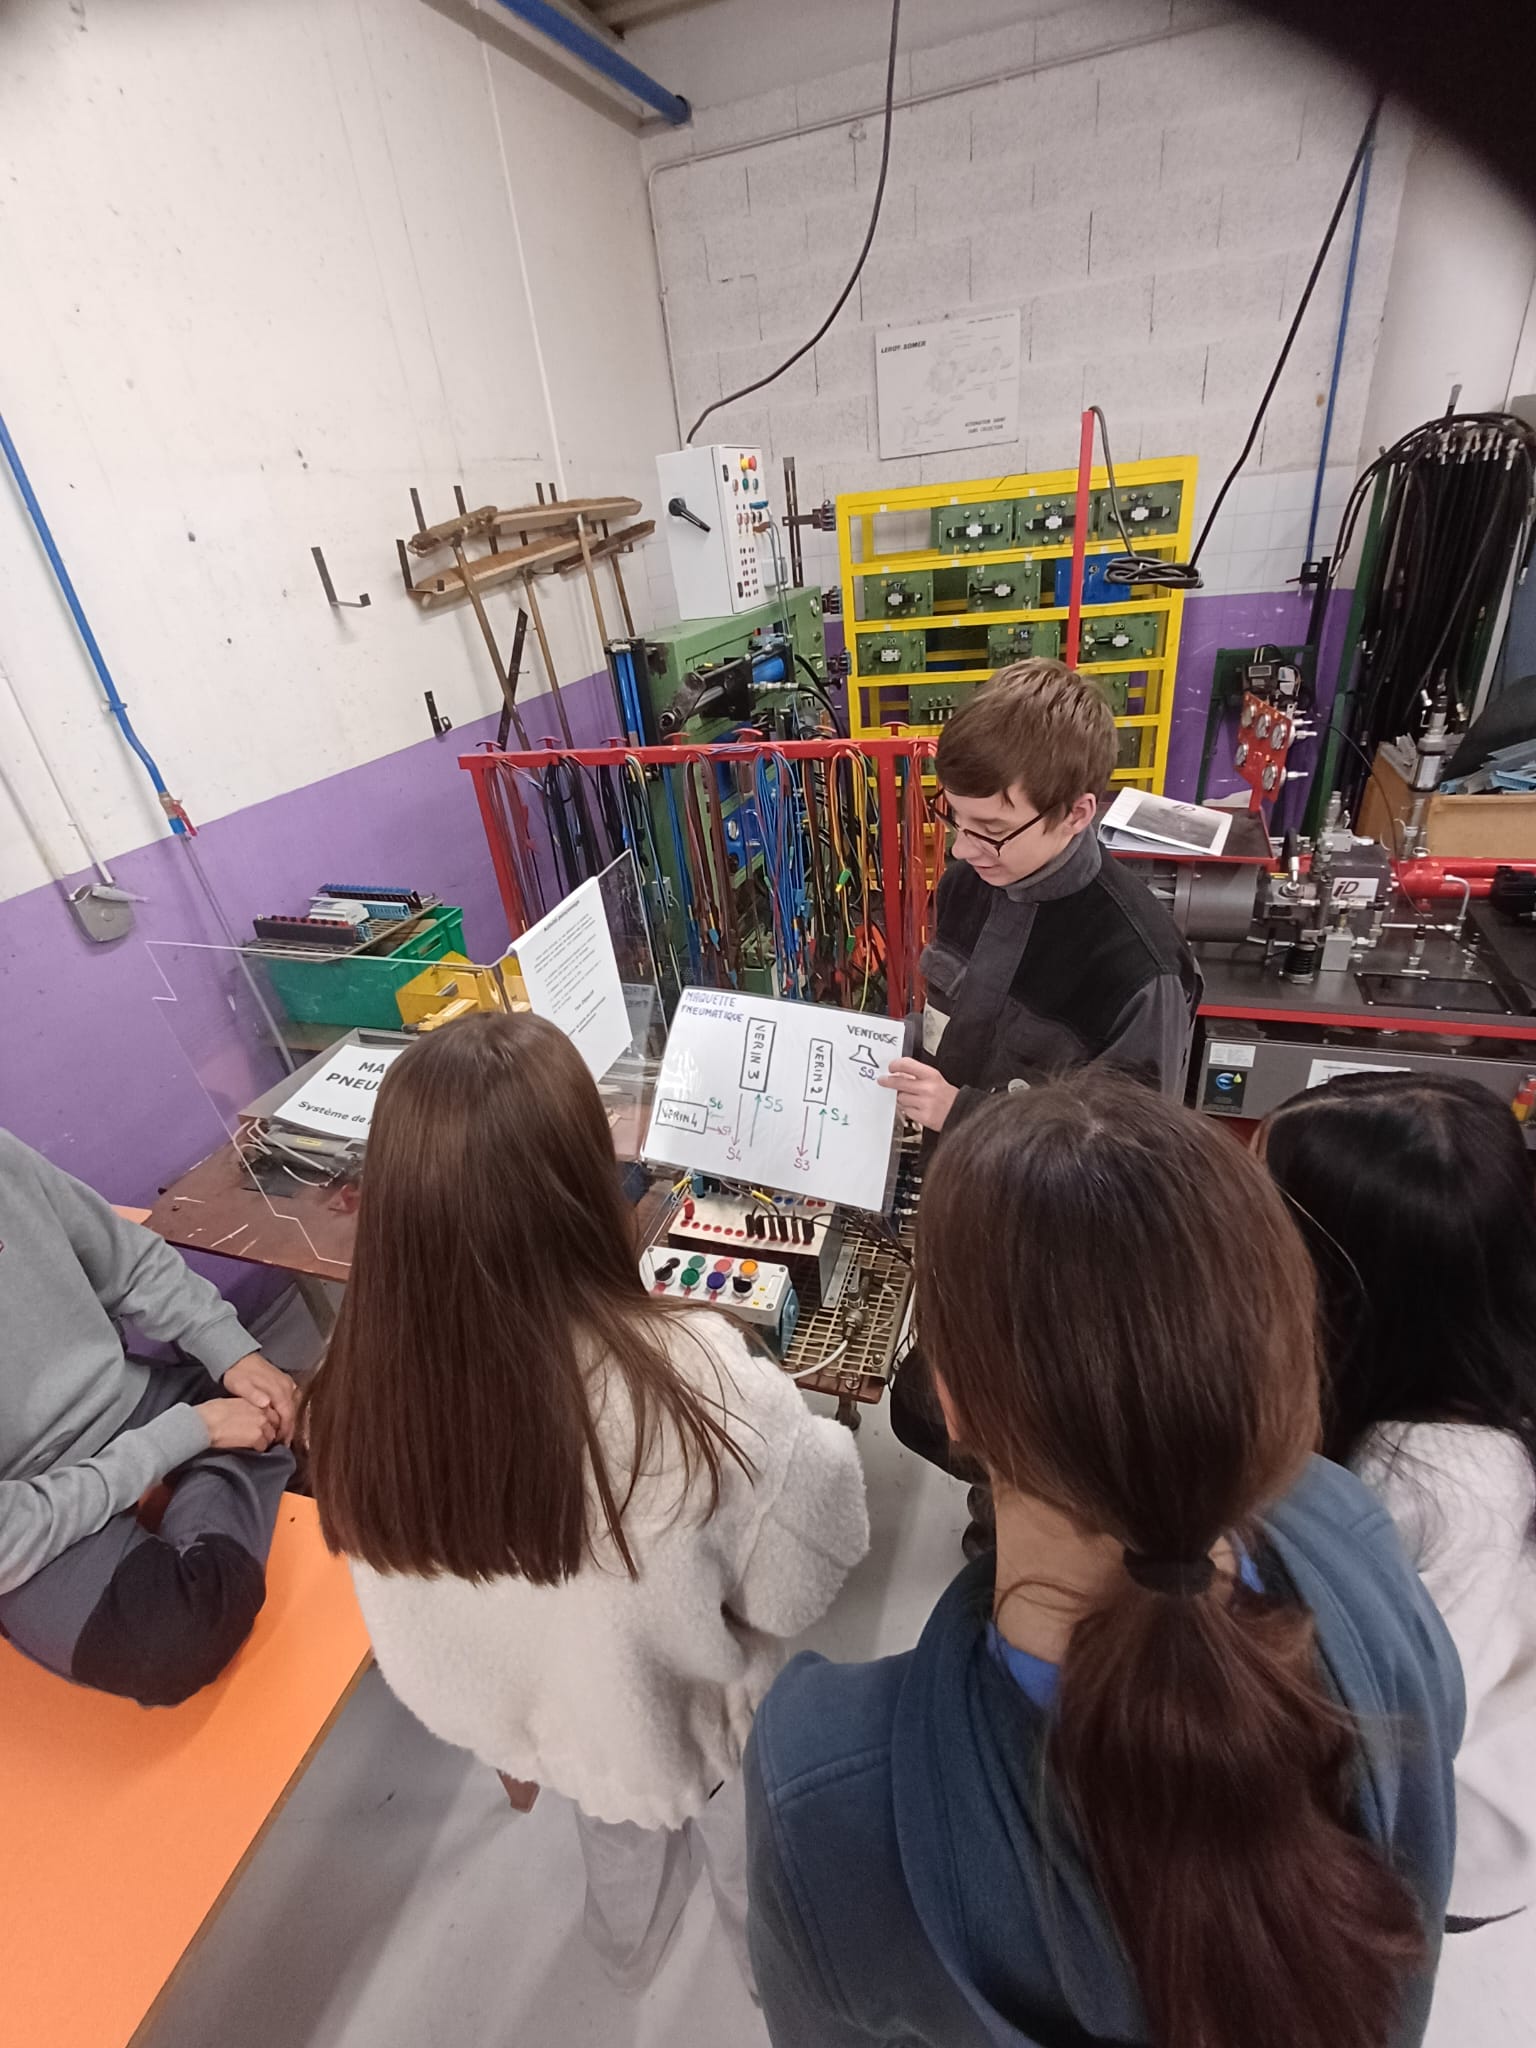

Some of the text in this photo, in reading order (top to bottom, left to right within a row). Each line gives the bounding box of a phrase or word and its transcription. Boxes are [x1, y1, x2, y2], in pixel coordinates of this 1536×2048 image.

[684, 991, 737, 1008] MAQUETTE
[680, 1004, 745, 1023] PNEUMATIQUE
[846, 1024, 899, 1047] VENTOUSE
[747, 1024, 765, 1080] VERIN 3
[810, 1045, 825, 1094] VERIN 2
[858, 1065, 876, 1081] S2
[326, 1072, 379, 1092] PNEU
[297, 1100, 350, 1120] Système
[351, 1114, 367, 1124] de
[708, 1096, 724, 1110] S6
[763, 1095, 784, 1113] S5
[690, 1112, 698, 1128] 4
[830, 1107, 850, 1126] S1
[726, 1145, 742, 1163] S4
[793, 1157, 811, 1172] S3
